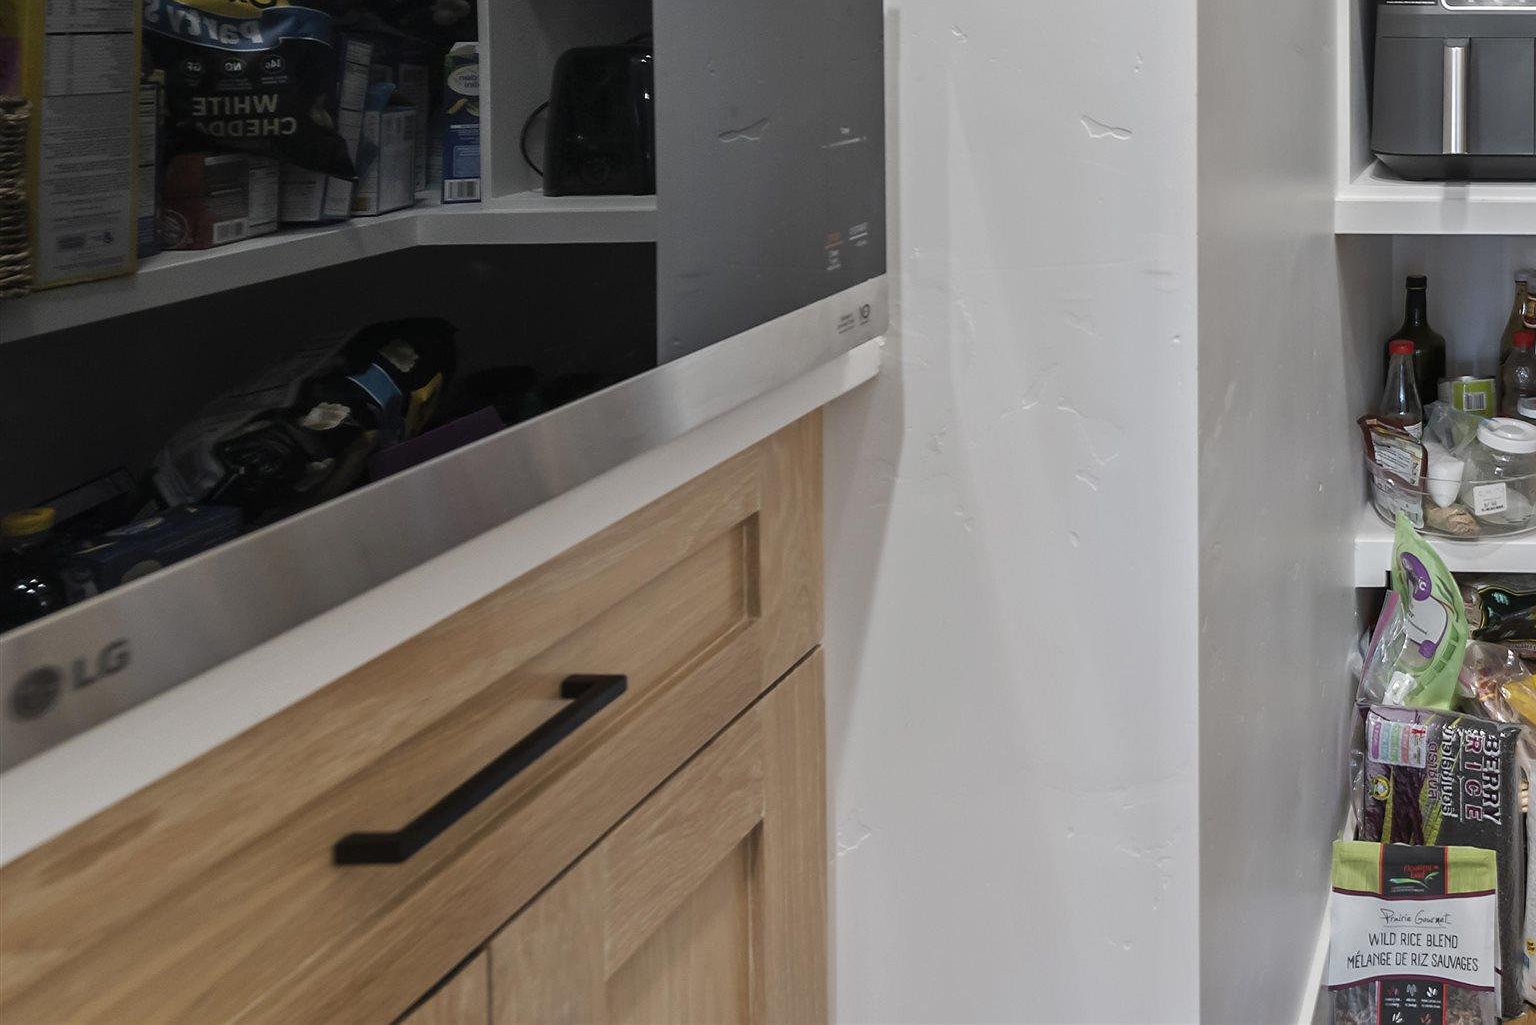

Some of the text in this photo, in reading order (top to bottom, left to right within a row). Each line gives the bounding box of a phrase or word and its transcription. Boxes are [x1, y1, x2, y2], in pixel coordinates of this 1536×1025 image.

[71, 637, 132, 691] LG
[1464, 734, 1483, 822] RICE
[1481, 731, 1502, 825] BERRY
[1380, 907, 1452, 925] Prairie Gourmet
[1368, 932, 1459, 949] WILD RICE BLEND
[1346, 950, 1479, 972] MÉLANGE DE RIZ SAUVAGES
